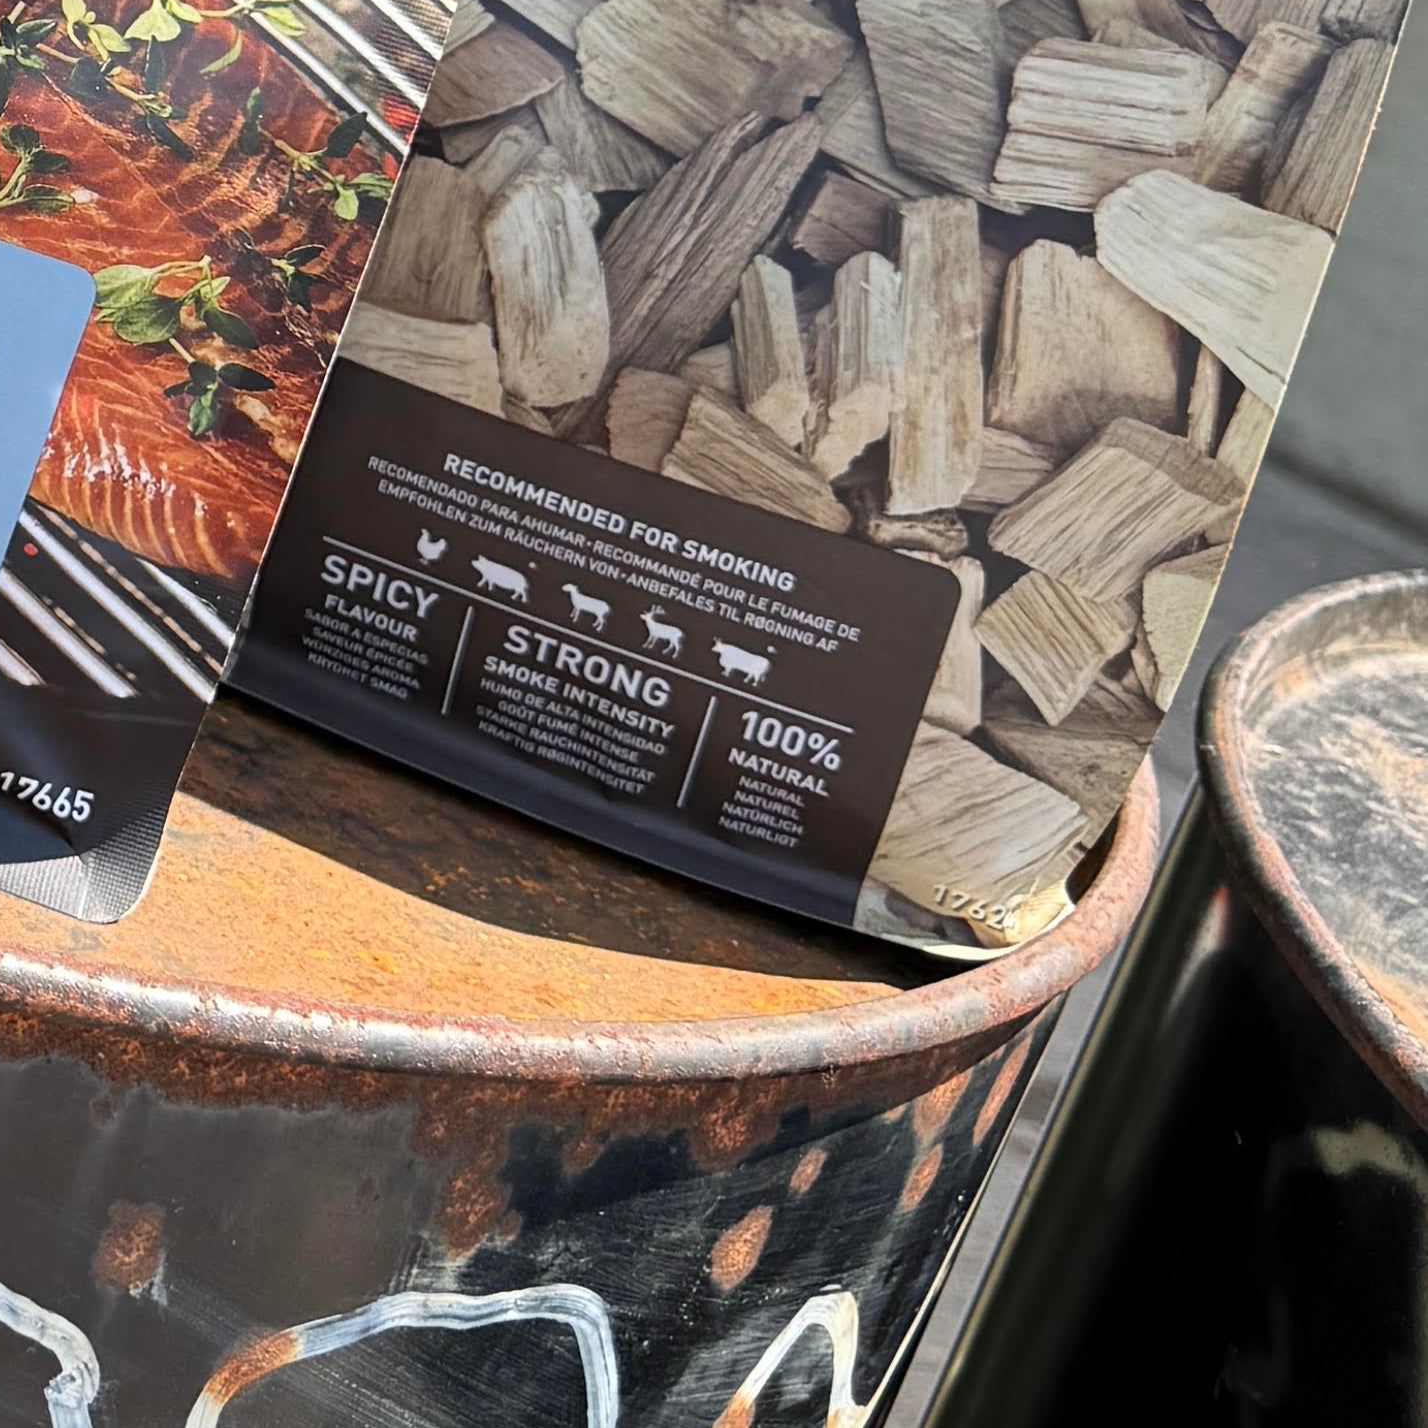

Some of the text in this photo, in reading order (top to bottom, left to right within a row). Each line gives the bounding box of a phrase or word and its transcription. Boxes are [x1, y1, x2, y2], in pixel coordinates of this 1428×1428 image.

[442, 454, 795, 591] RECOMMENDED FOR SMOKING
[323, 594, 418, 642] FLAVOUR
[319, 554, 843, 772] SPICY STRONG 100%
[483, 655, 676, 738] SMOKE INTENSITY
[0, 771, 95, 823] 17665
[728, 747, 830, 798] NATURAL
